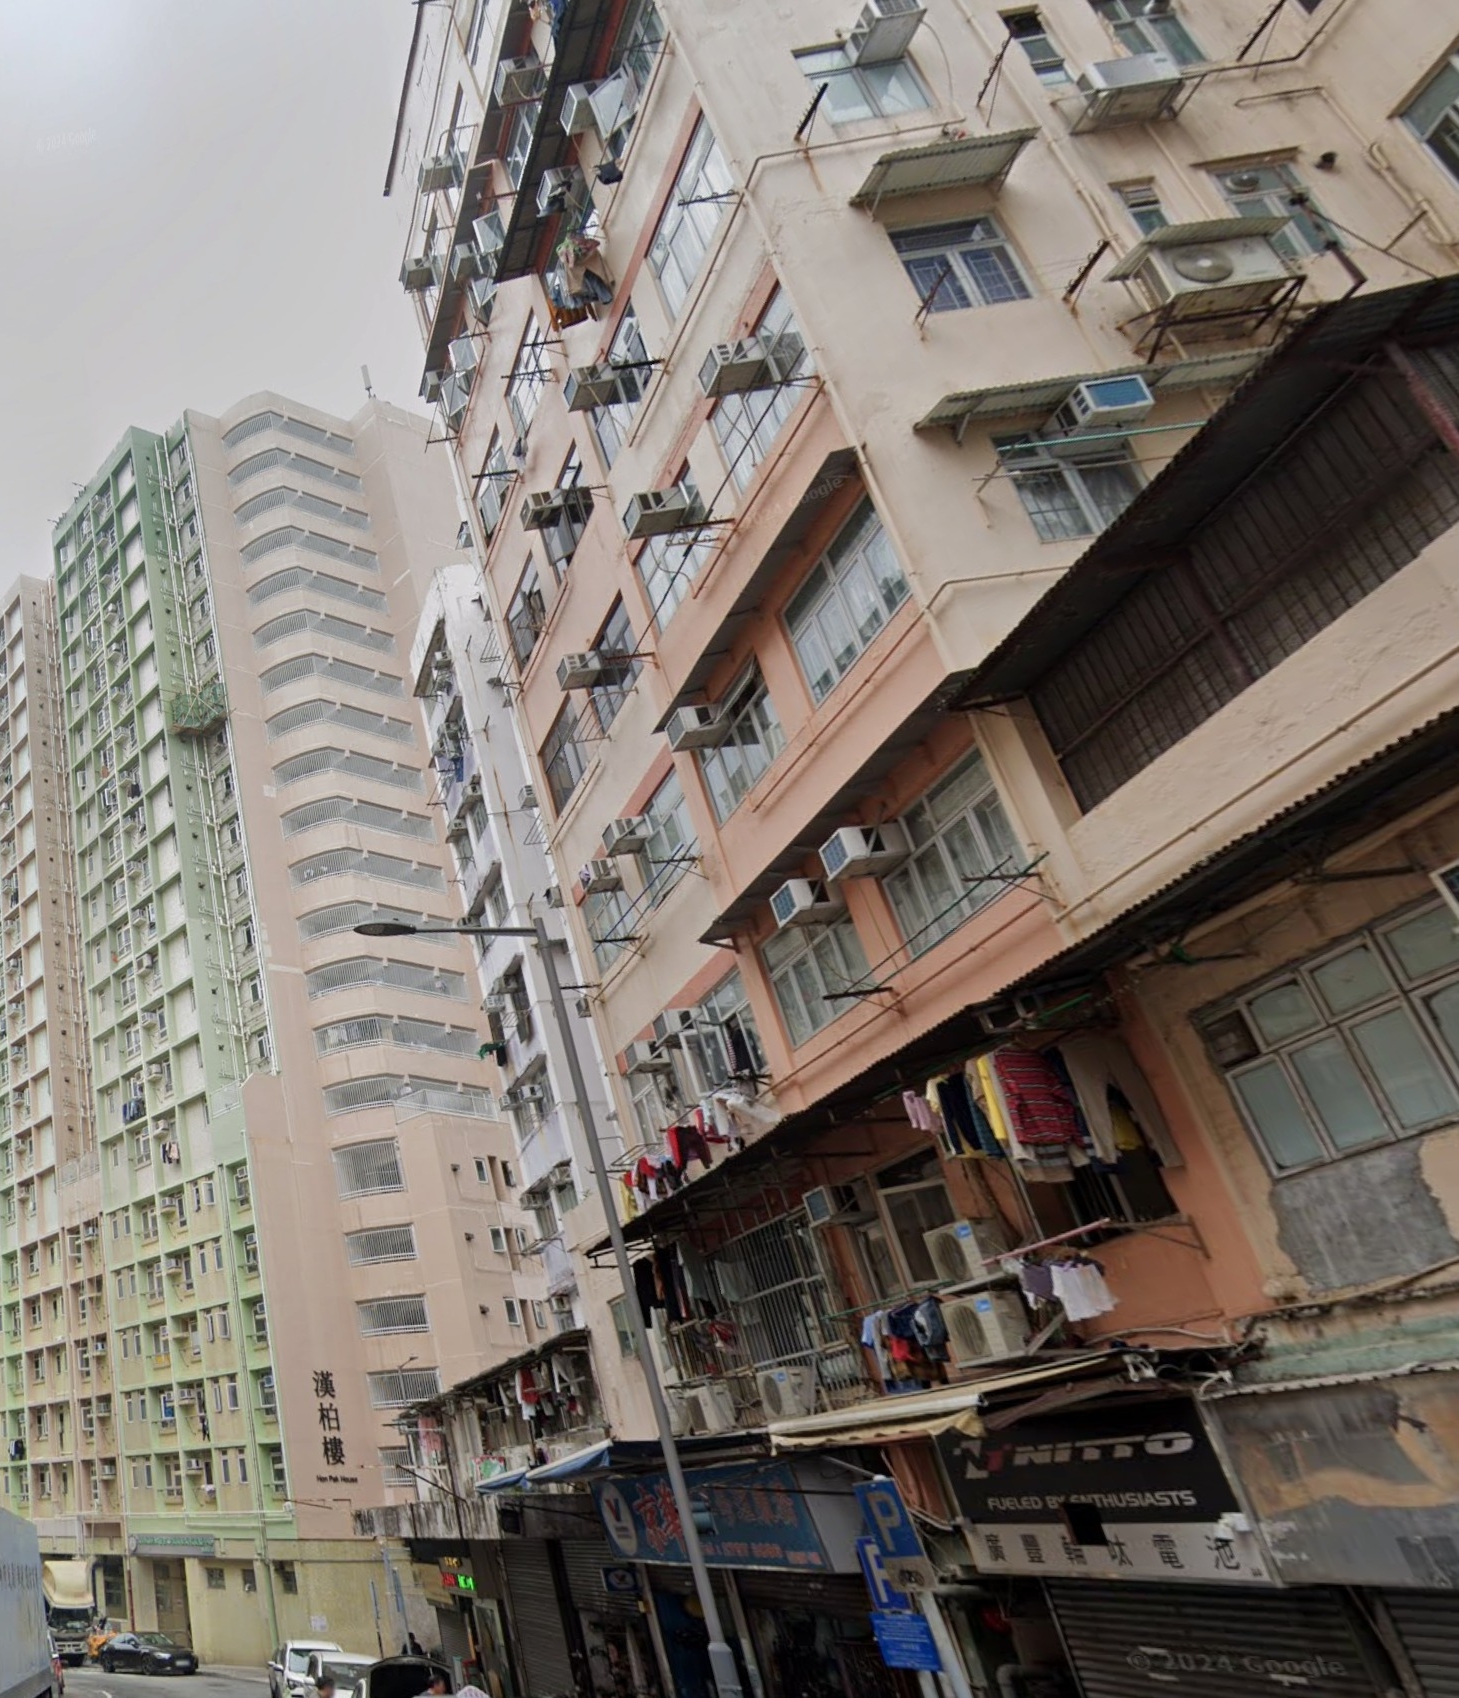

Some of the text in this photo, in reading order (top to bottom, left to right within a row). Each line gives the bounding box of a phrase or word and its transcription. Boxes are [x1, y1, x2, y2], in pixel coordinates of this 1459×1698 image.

[312, 1369, 345, 1466] 漢柏樓
[1013, 1431, 1194, 1466] NITTO
[868, 1490, 901, 1553] P
[987, 1489, 1198, 1511] FUELED BY ENTHUSIASTS
